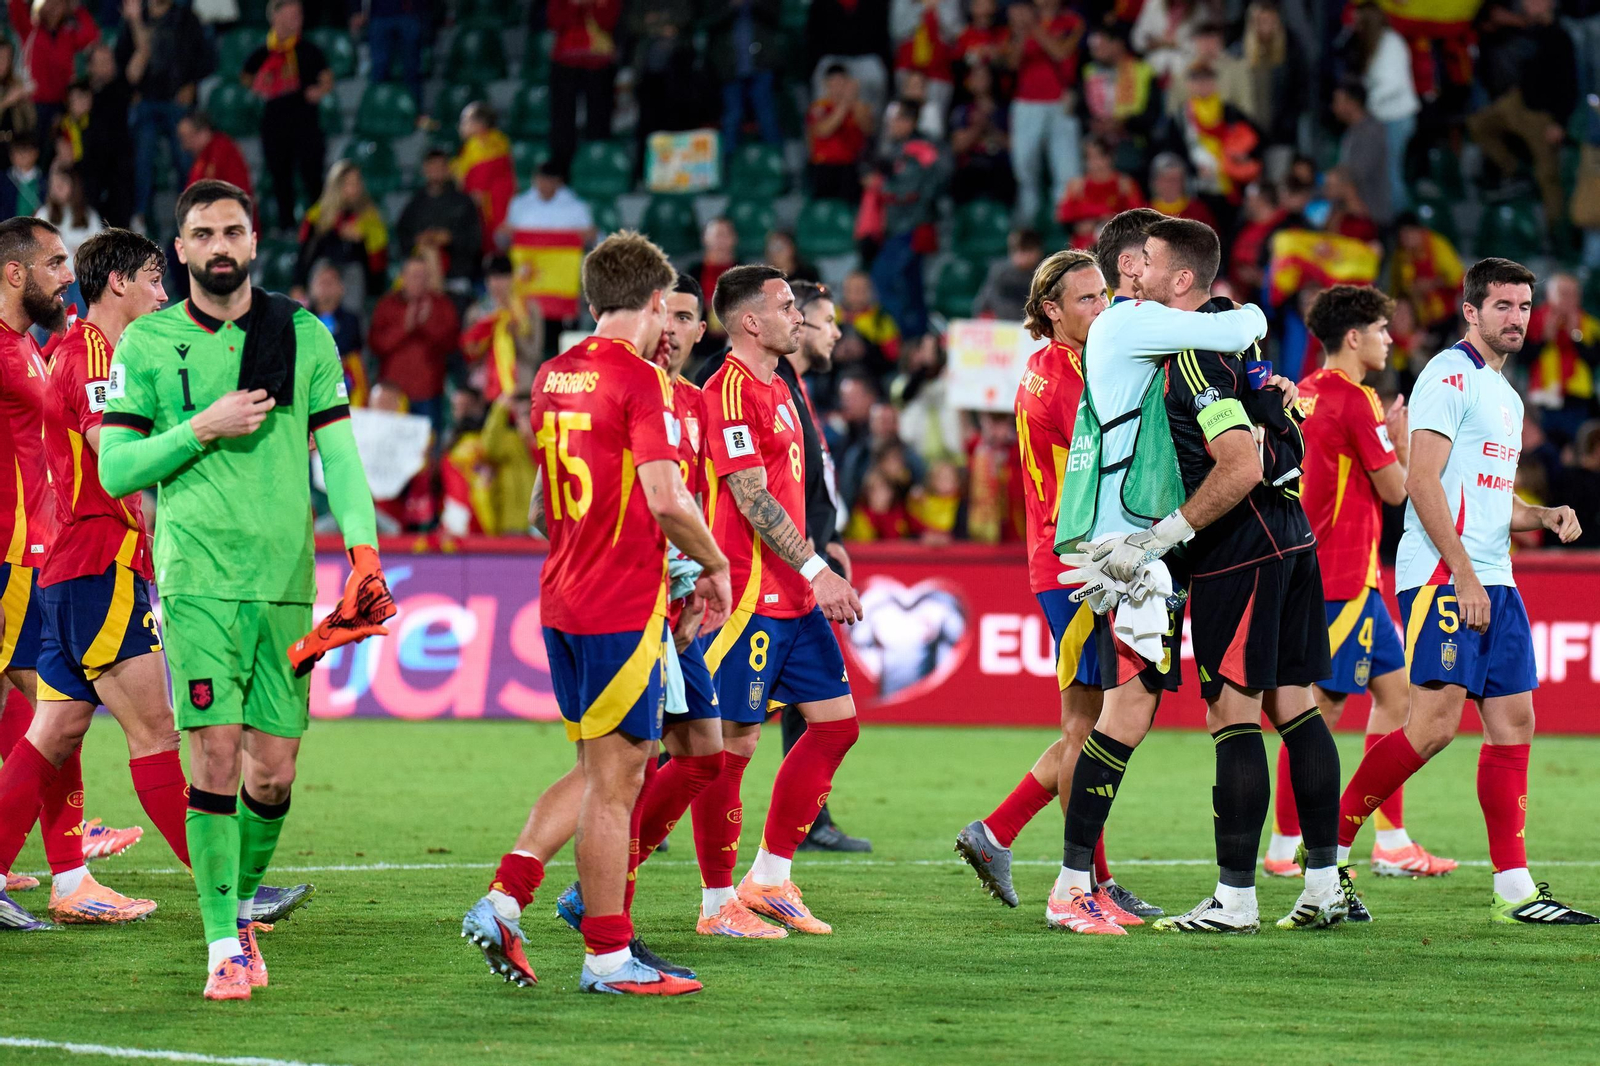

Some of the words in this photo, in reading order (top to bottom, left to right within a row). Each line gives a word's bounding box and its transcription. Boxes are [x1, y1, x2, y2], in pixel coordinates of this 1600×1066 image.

[178, 368, 196, 412] 1
[543, 371, 599, 393] BARRIOS
[1206, 409, 1233, 426] RESPECT
[536, 411, 592, 522] 15
[788, 442, 802, 483] 8
[1074, 583, 1104, 601] reusch
[142, 611, 163, 652] 3
[1437, 595, 1460, 634] 5
[749, 630, 770, 672] 8
[1357, 617, 1374, 654] 4
